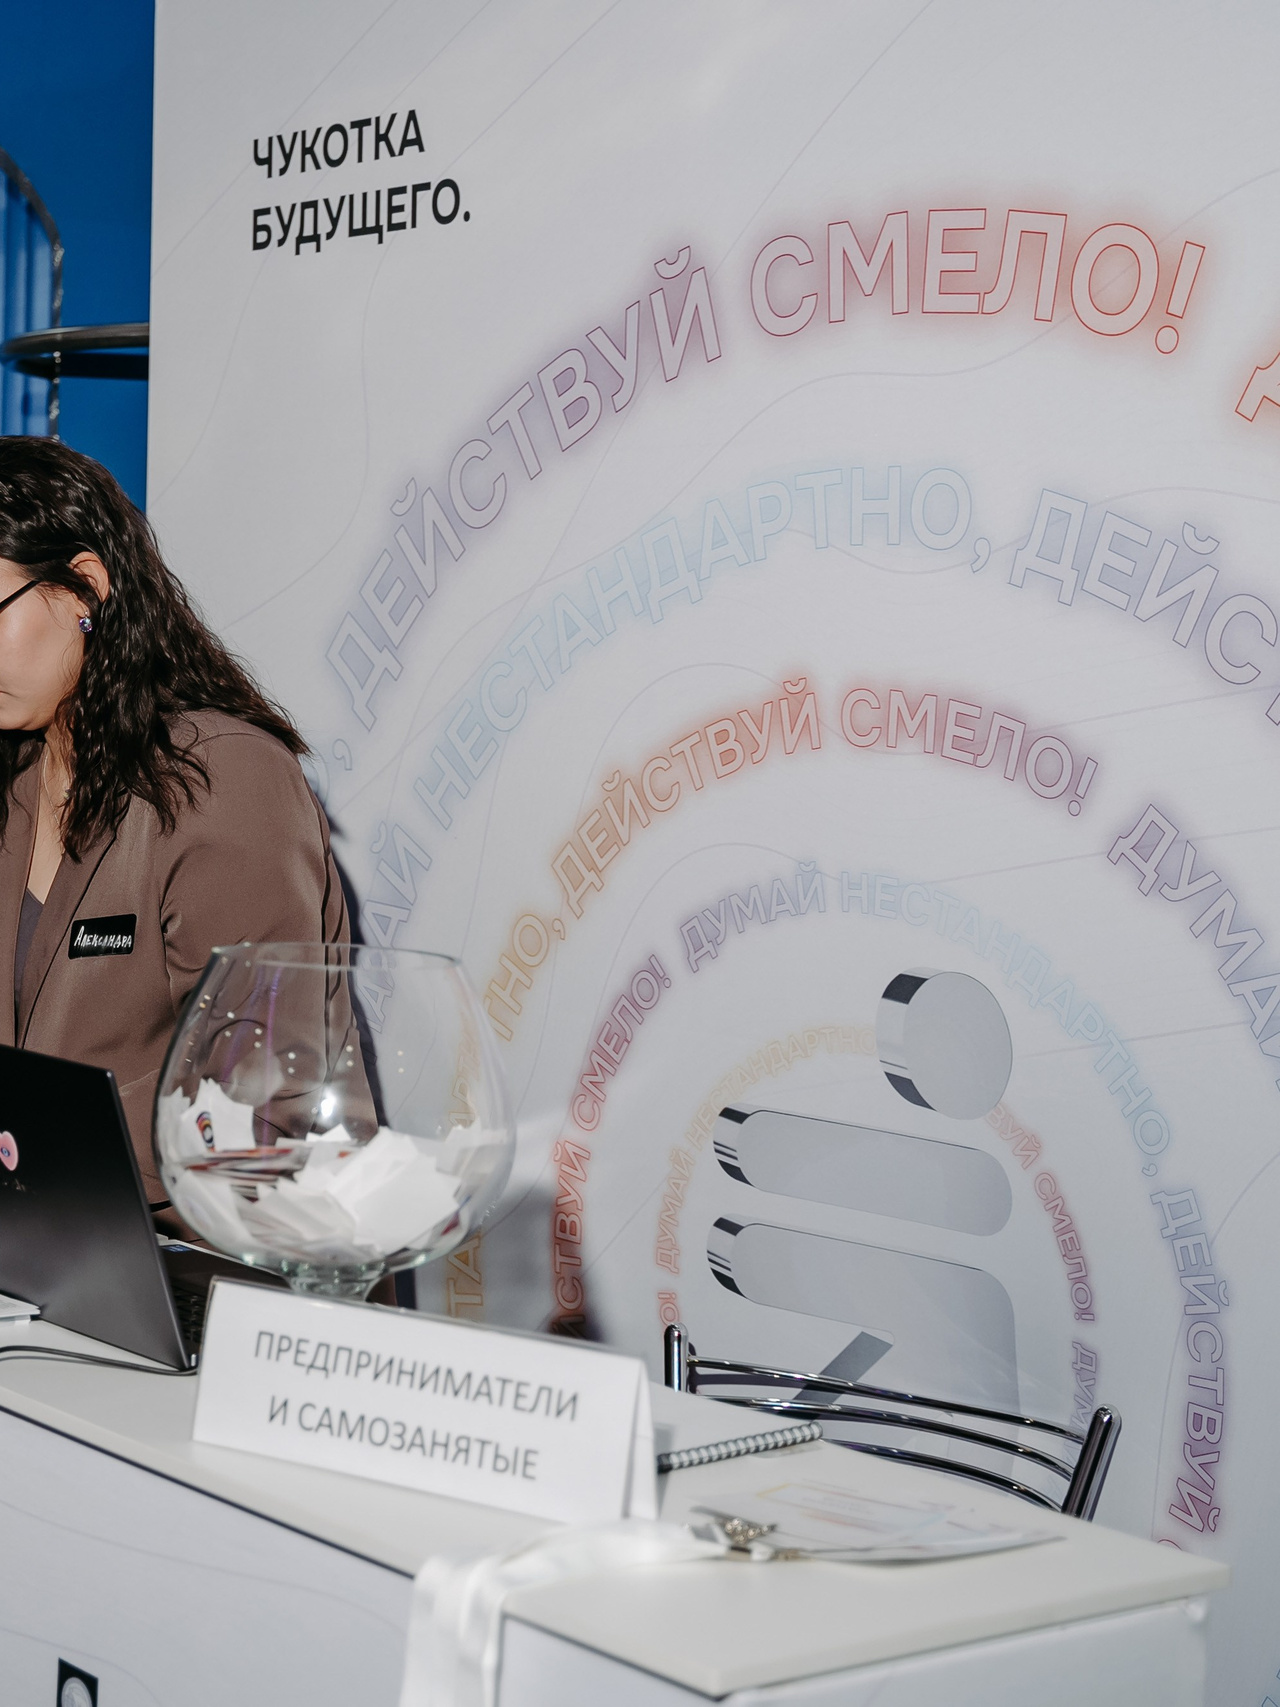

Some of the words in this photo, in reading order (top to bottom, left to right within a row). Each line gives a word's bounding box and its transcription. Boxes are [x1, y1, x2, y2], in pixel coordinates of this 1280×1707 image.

[253, 109, 425, 178] ЧУКОТКА
[252, 178, 471, 256] БУДУЩЕГО.
[325, 246, 721, 731] ДЕЙСТВУЙ
[750, 208, 1205, 354] СМЕЛО!
[414, 466, 990, 830] НЕСТАНДАРТНО,
[1007, 489, 1280, 726] ДЕЙС
[551, 678, 821, 919] ДЕЙСТВУЙ
[841, 688, 1098, 816] СМЕЛО!
[572, 954, 672, 1131] СМЕЛО!
[679, 861, 826, 973] ДУМАЙ
[840, 871, 1170, 1177] НЕСТАНДАРТНО,
[1150, 1188, 1231, 1533] ДЕЙСТВУЙ
[656, 1147, 695, 1274] ДУМАЙ
[1034, 1172, 1095, 1322] СМЕЛО!
[254, 1331, 580, 1422] ПРЕДПРИНИМАТЕЛИ
[268, 1396, 290, 1426] И
[298, 1402, 540, 1480] САМОЗАНЯТЫЕ
